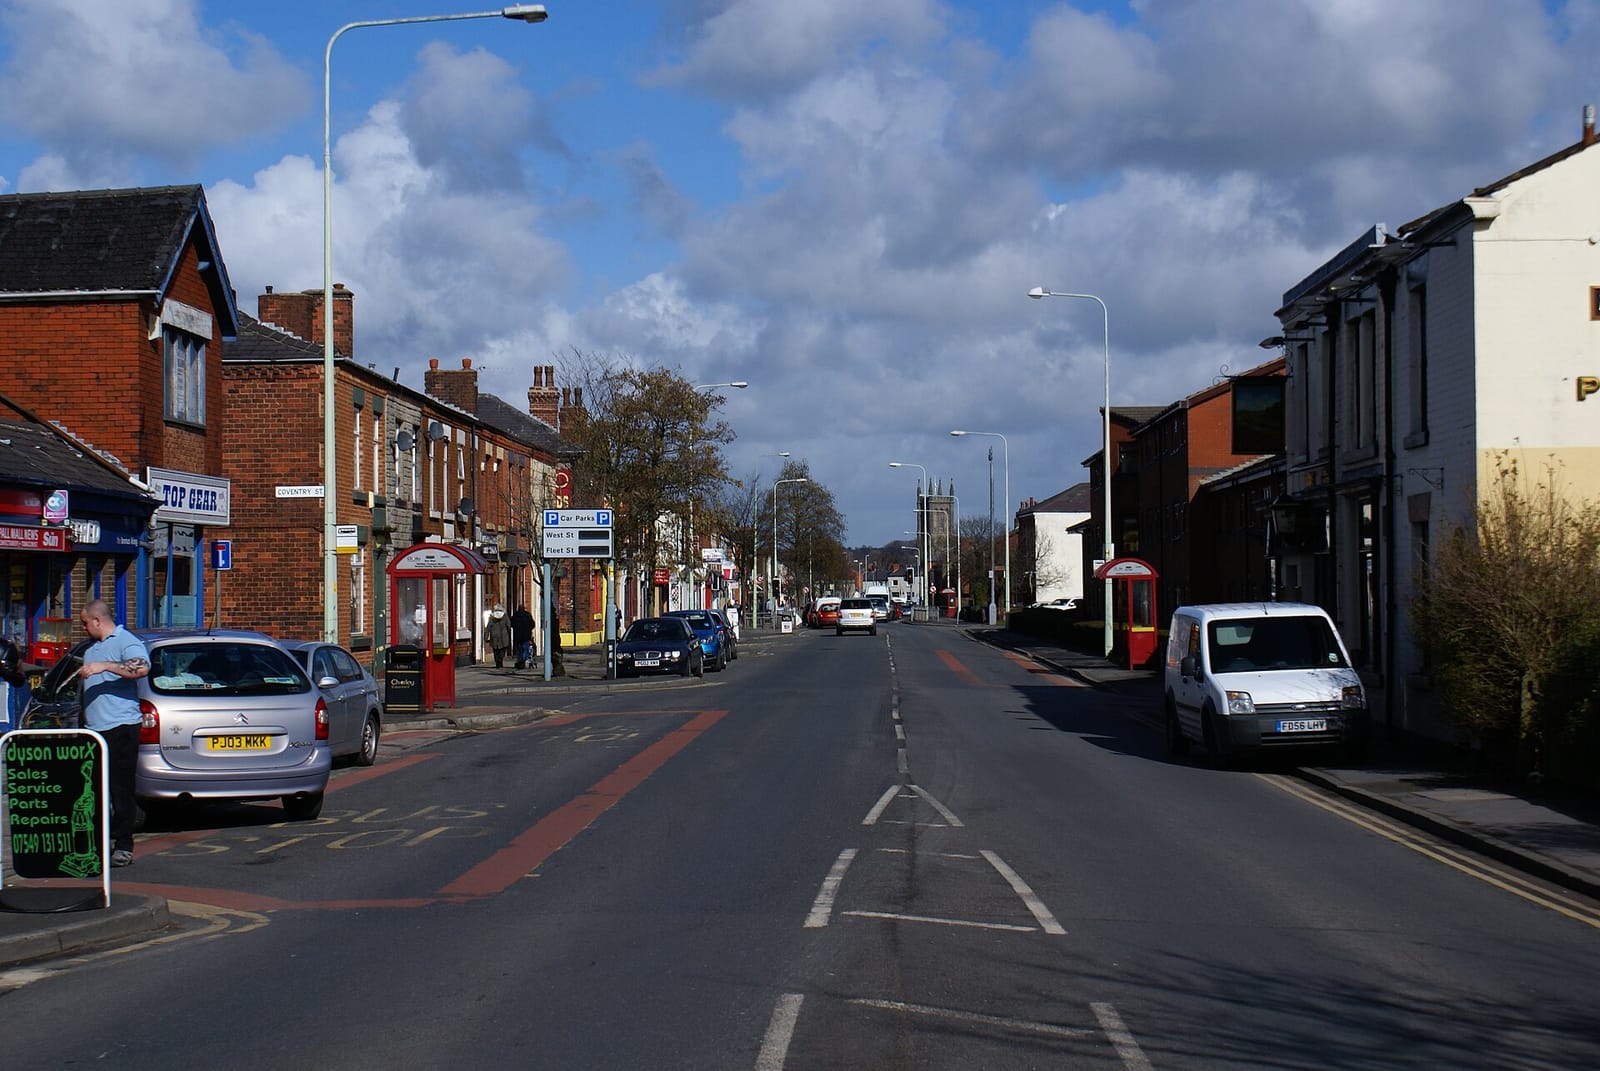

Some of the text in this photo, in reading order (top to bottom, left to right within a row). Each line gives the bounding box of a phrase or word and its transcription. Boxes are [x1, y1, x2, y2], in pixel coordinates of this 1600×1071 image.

[162, 485, 217, 512] TOP GEAR
[277, 488, 323, 496] COVENTRY ST
[43, 532, 59, 547] Sun
[1307, 721, 1325, 730] LHV
[211, 735, 267, 748] PJ03 MKK
[7, 743, 52, 766] dyson
[7, 768, 49, 780] Sales
[7, 782, 63, 794] Service
[9, 798, 49, 809] Parts
[10, 813, 69, 828] Repairs
[12, 832, 72, 854] 07549 131 511
[154, 827, 498, 857] STOP
